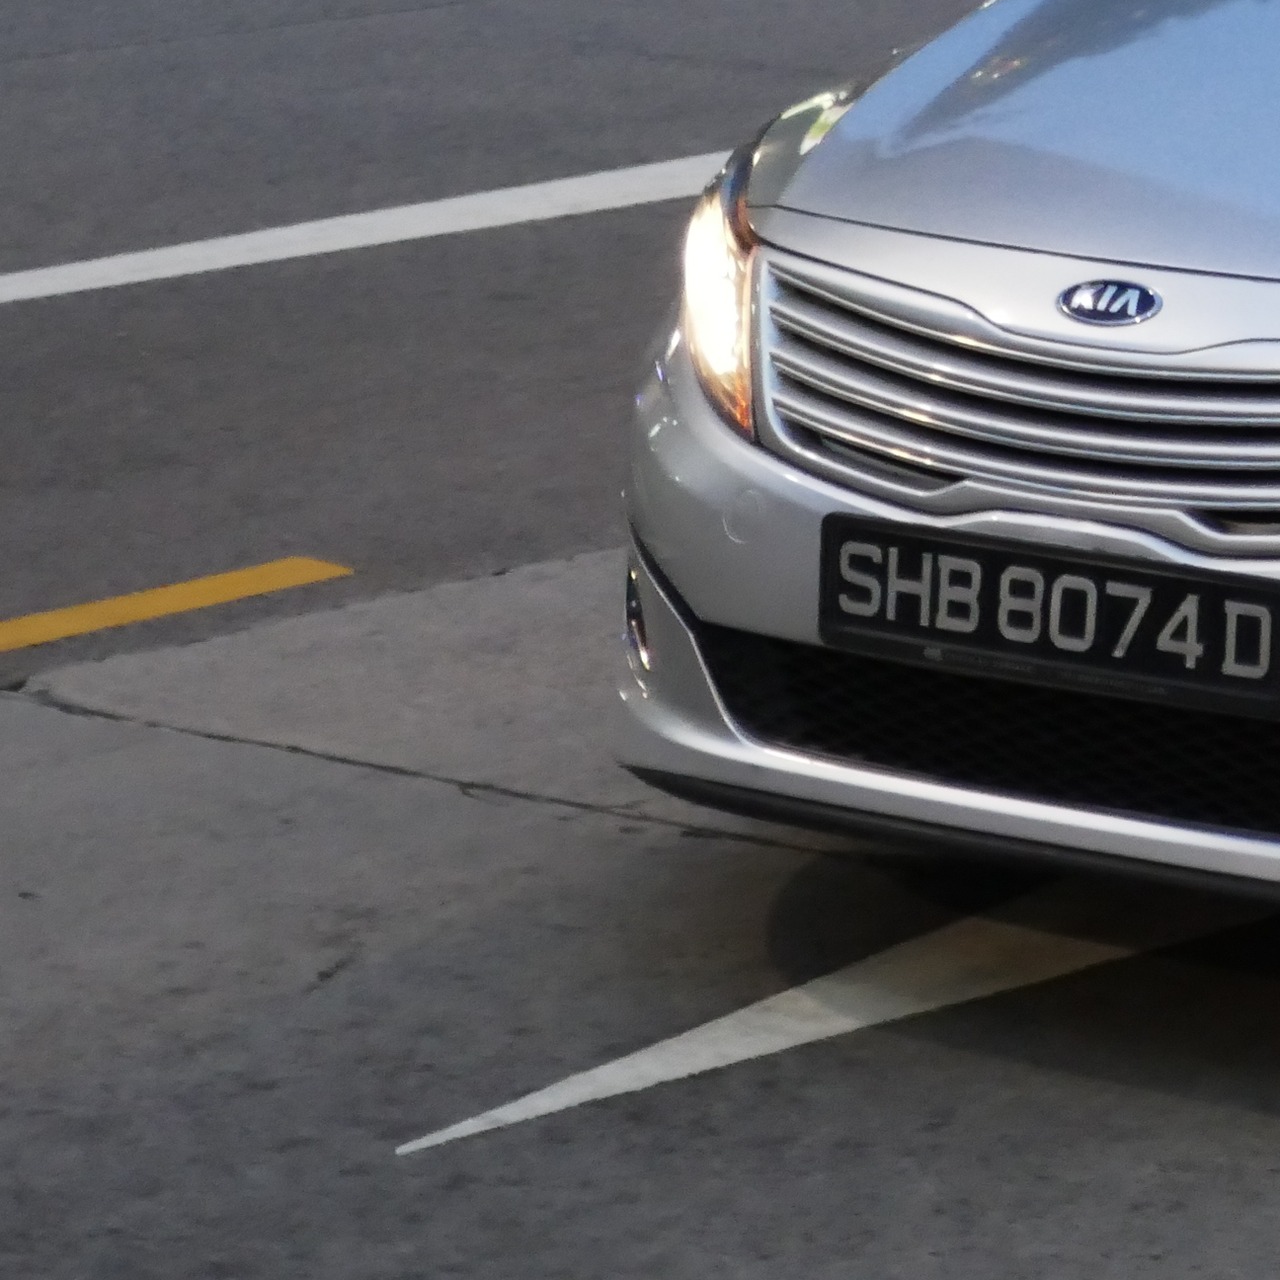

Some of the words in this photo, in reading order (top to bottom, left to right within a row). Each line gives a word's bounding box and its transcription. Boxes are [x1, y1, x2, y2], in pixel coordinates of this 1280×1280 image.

[1070, 283, 1140, 317] KIA
[839, 541, 982, 635] SHB
[997, 565, 1206, 670] 8074
